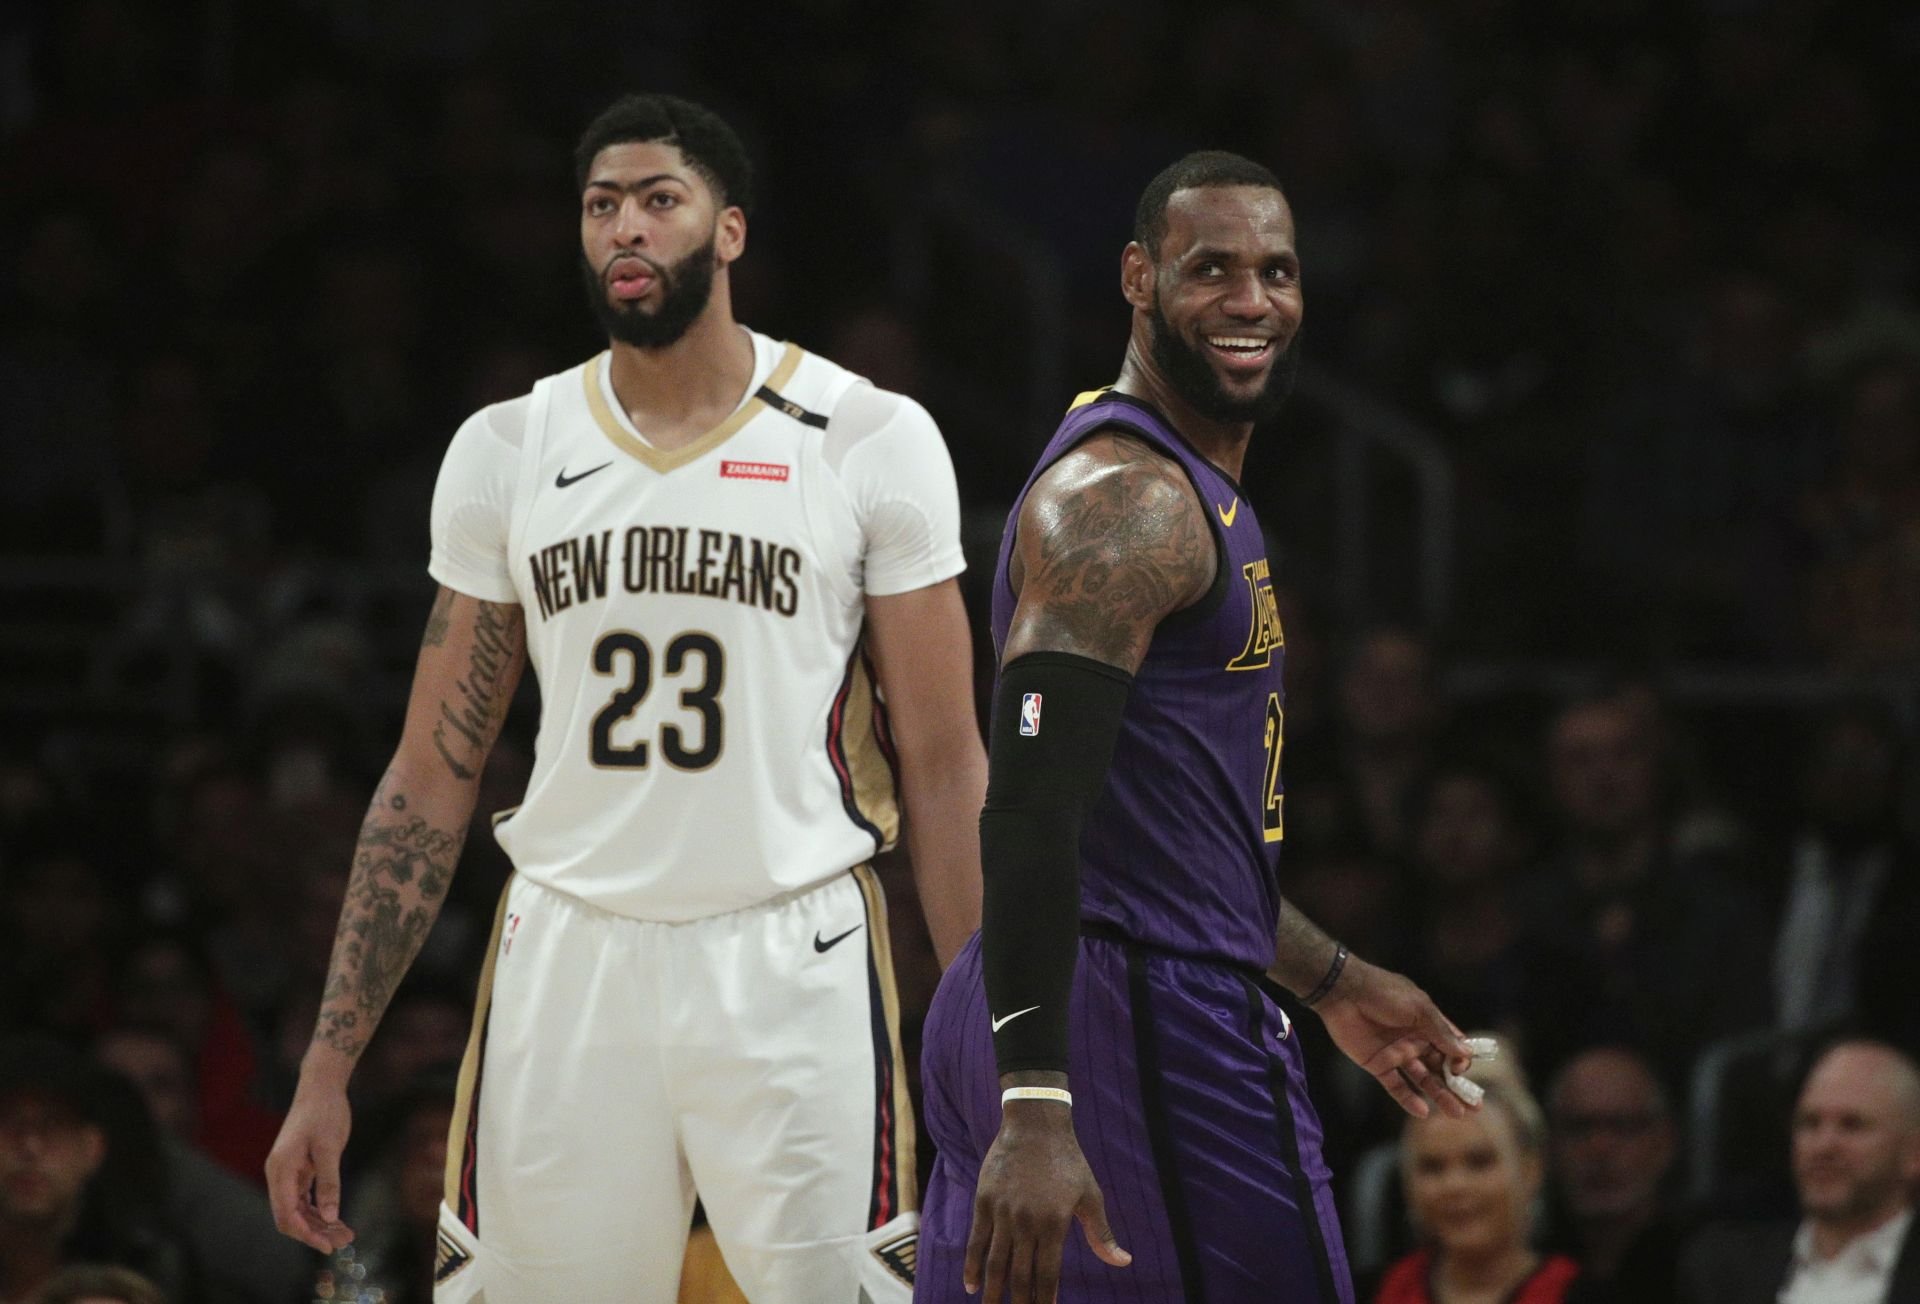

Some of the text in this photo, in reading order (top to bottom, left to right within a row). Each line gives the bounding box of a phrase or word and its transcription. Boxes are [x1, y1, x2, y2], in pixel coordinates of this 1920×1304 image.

[529, 526, 801, 622] NEW ORLEANS
[590, 628, 727, 772] 23
